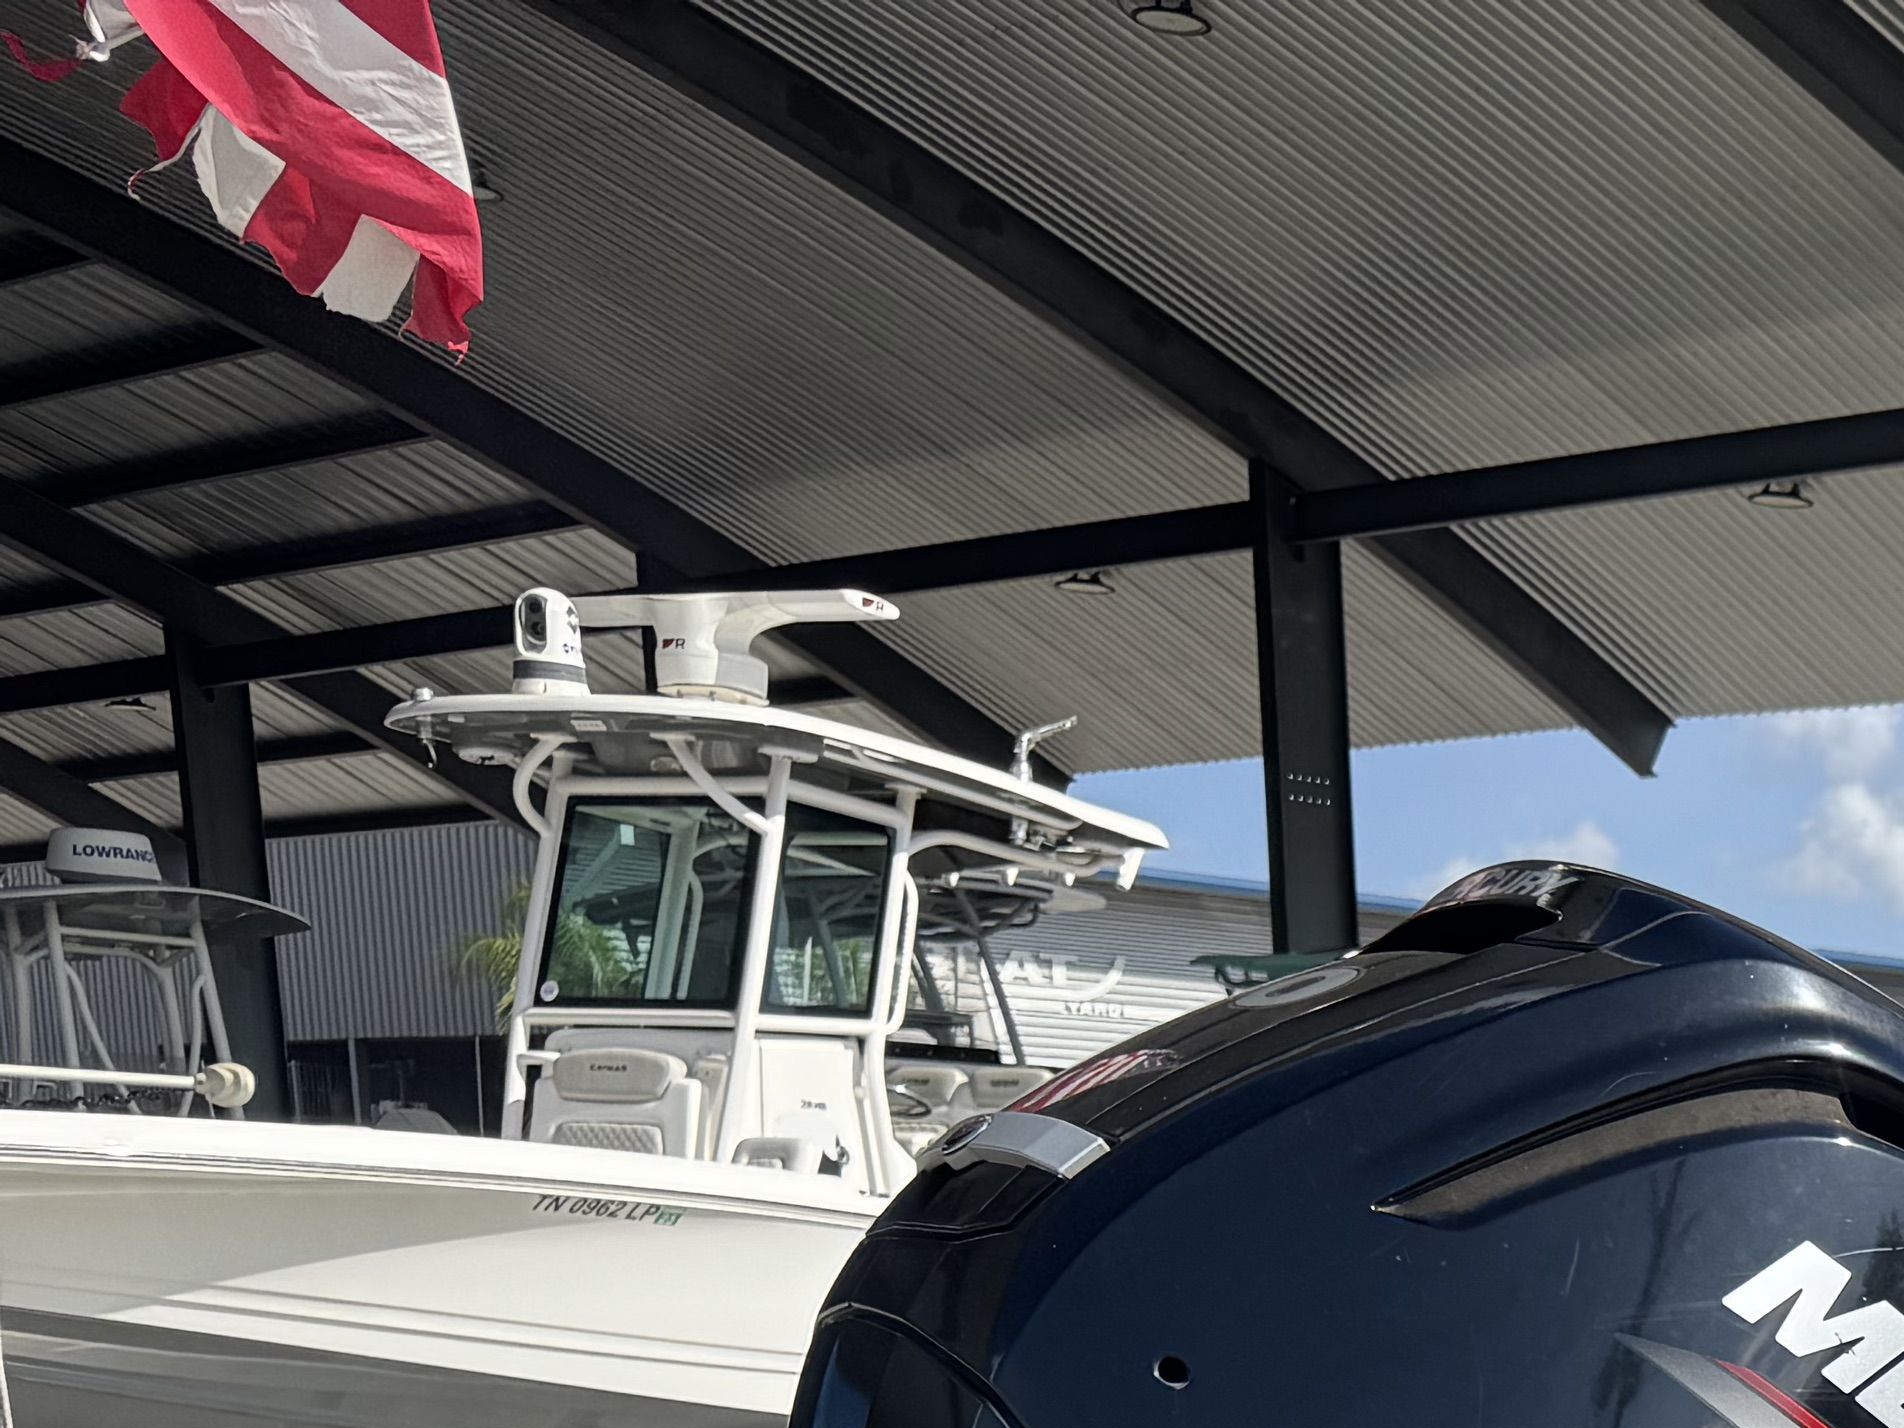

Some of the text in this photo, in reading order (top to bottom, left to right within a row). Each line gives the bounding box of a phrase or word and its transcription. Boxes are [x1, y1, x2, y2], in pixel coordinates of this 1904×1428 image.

[72, 843, 156, 864] LOWRANC
[532, 1193, 570, 1212] TN
[568, 1197, 628, 1218] 0962
[625, 1202, 661, 1222] LP
